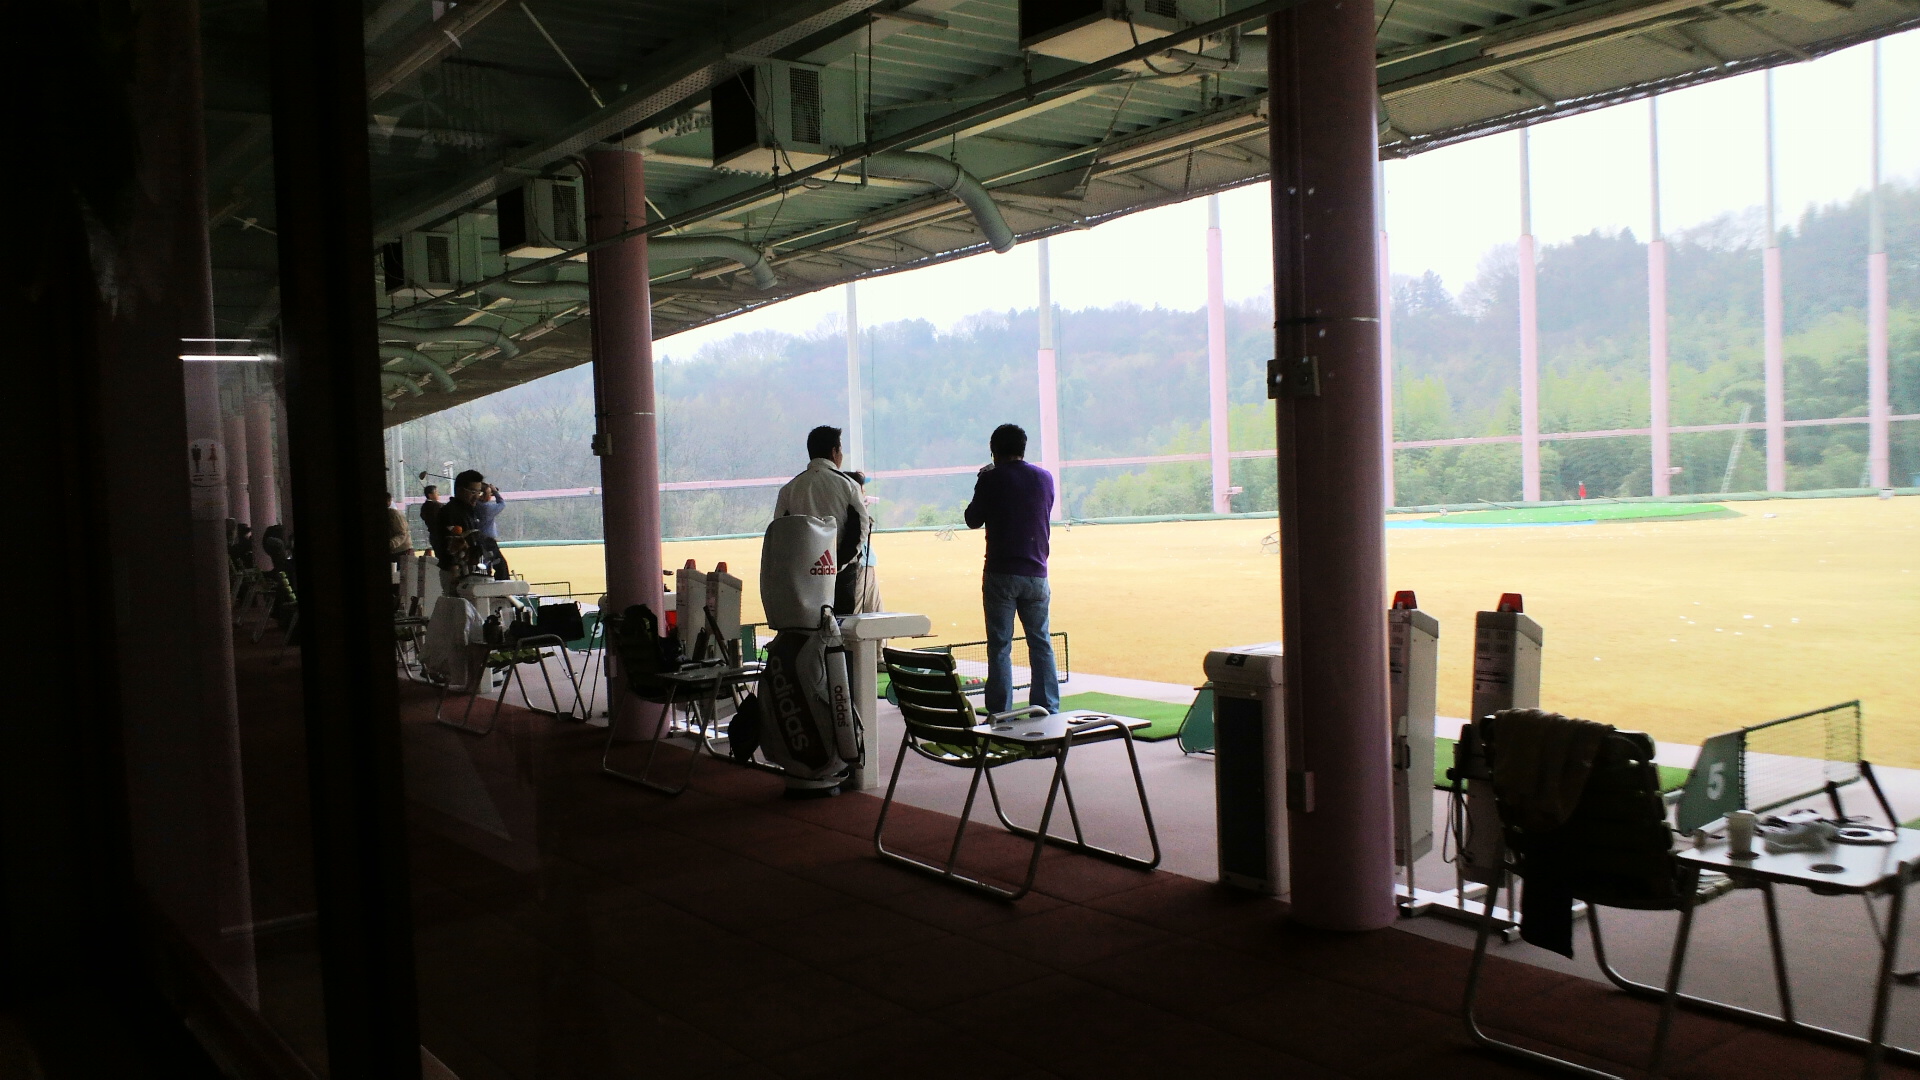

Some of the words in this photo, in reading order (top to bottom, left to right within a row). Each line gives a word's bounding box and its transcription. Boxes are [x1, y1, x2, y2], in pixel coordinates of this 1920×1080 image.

[810, 565, 836, 576] adidas
[770, 655, 809, 751] adidas
[834, 685, 849, 728] adidas
[1707, 761, 1725, 800] 5
